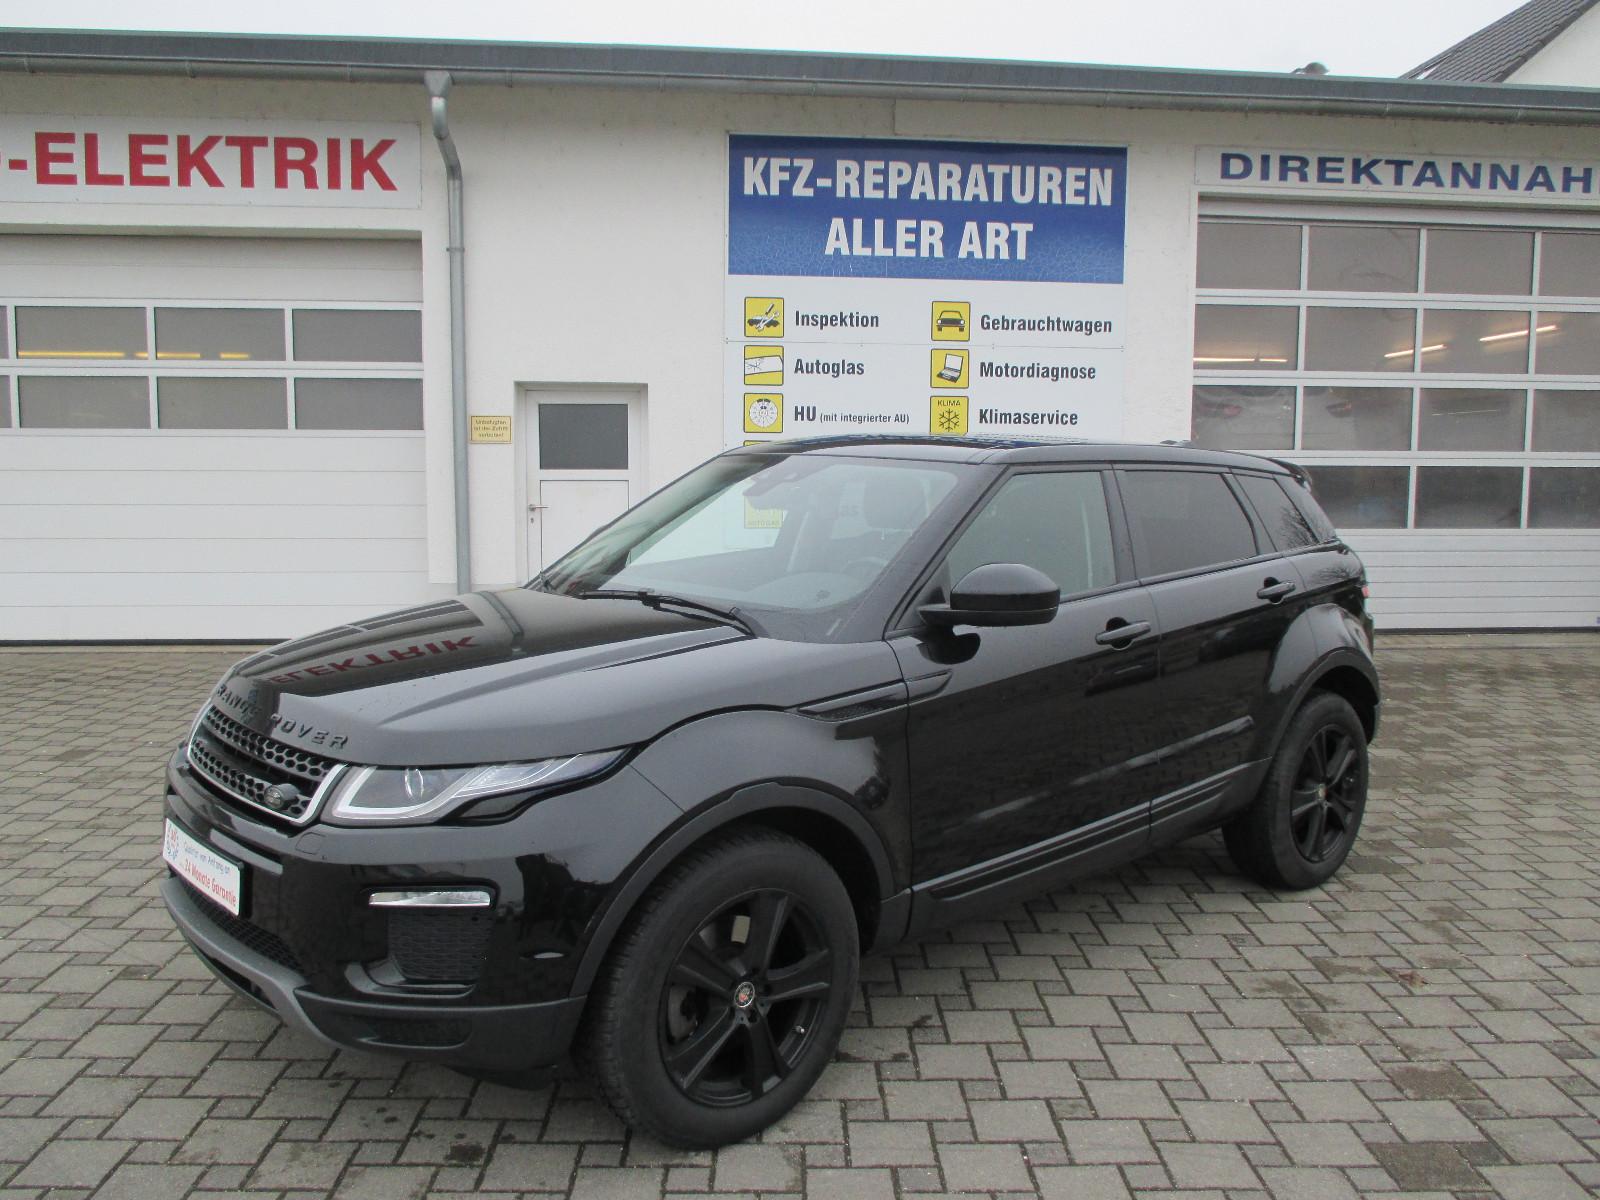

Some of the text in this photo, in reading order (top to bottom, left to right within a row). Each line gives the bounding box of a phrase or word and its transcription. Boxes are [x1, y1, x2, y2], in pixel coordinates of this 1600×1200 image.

[0, 131, 398, 191] -ELEKTRIK
[743, 156, 1112, 206] KFZ-REPARATUREN
[1220, 152, 1600, 194] DIREKTANNAH
[824, 217, 1033, 260] ALLER ART
[795, 310, 879, 330] Inspektion
[980, 314, 1112, 336] Gebrauchtwagen
[794, 358, 865, 379] Autoglas
[979, 362, 1096, 382] Motordiagnose
[794, 405, 910, 424] HU (mit integrierter AU)
[978, 409, 1078, 425] Klimaservice
[271, 713, 348, 750] ROVER
